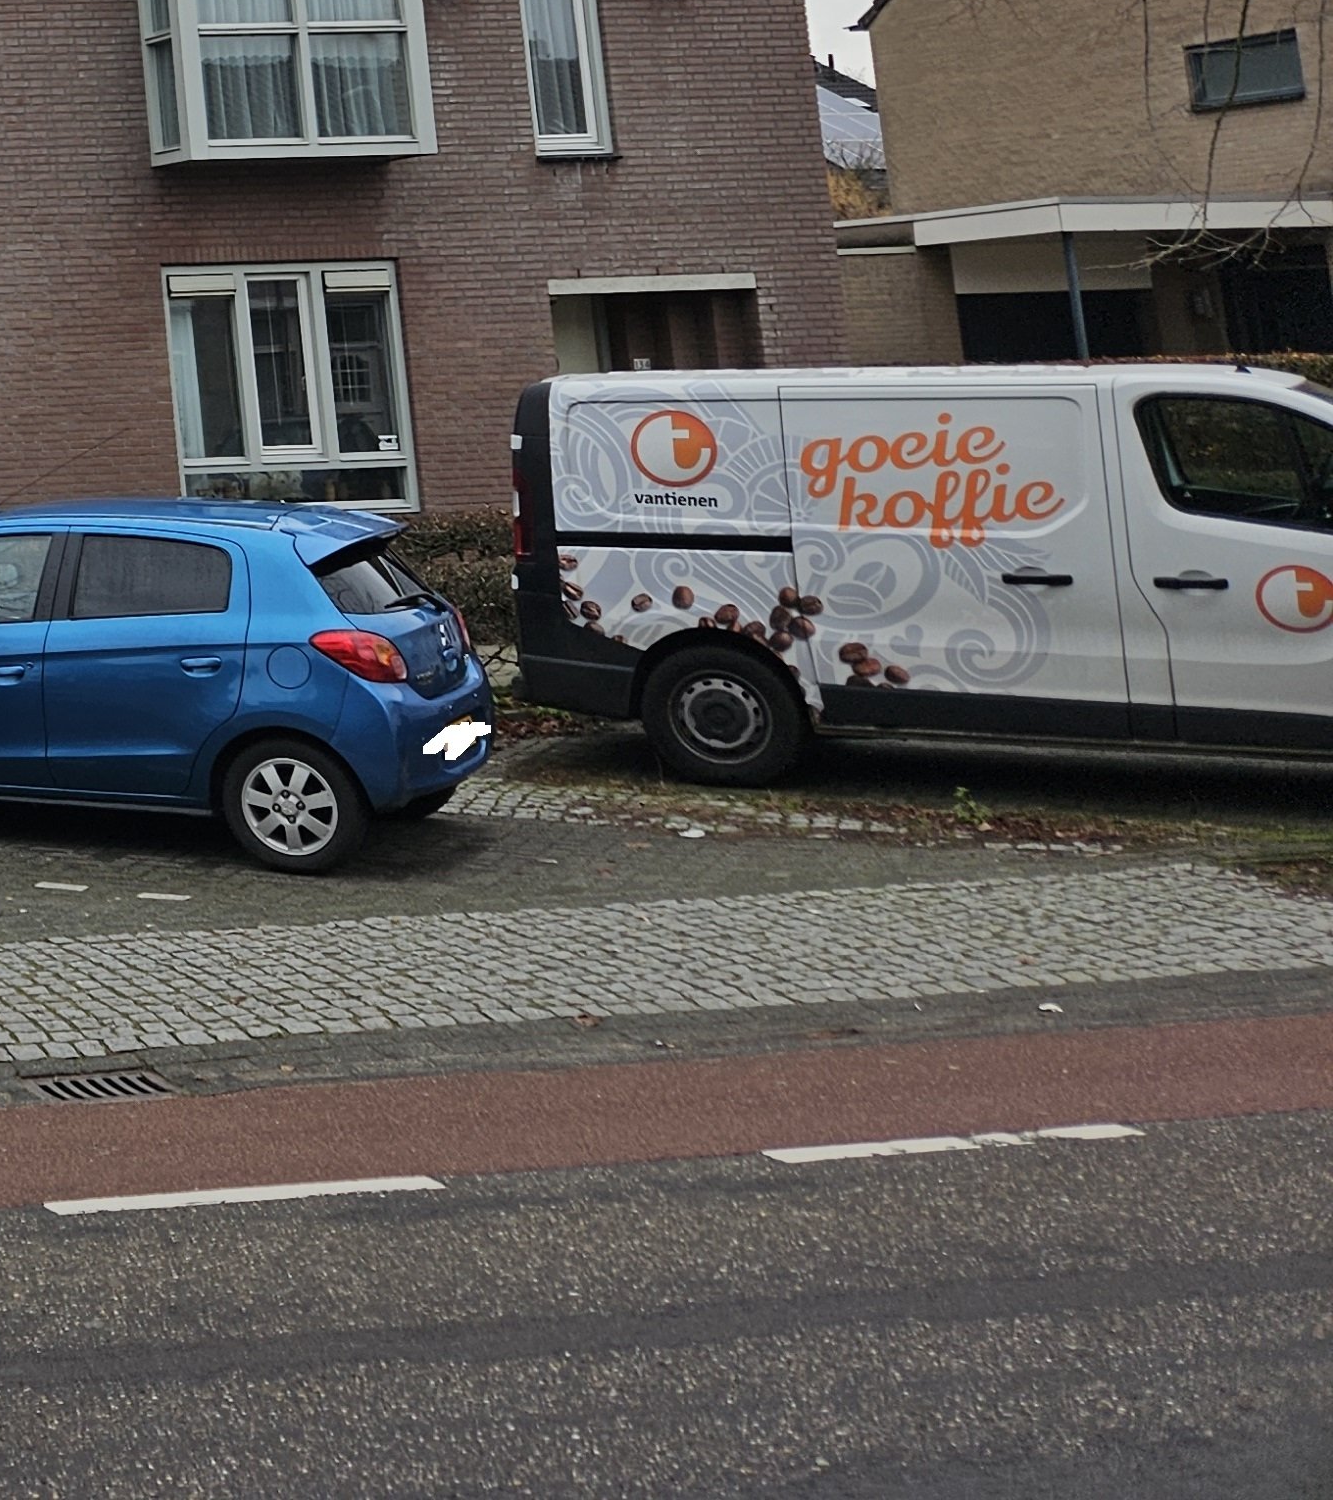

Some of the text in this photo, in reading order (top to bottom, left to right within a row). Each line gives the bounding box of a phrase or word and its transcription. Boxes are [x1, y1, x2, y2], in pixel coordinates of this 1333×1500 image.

[800, 412, 1006, 499] goeie
[634, 491, 718, 508] vantienen
[838, 462, 1065, 549] koffie
